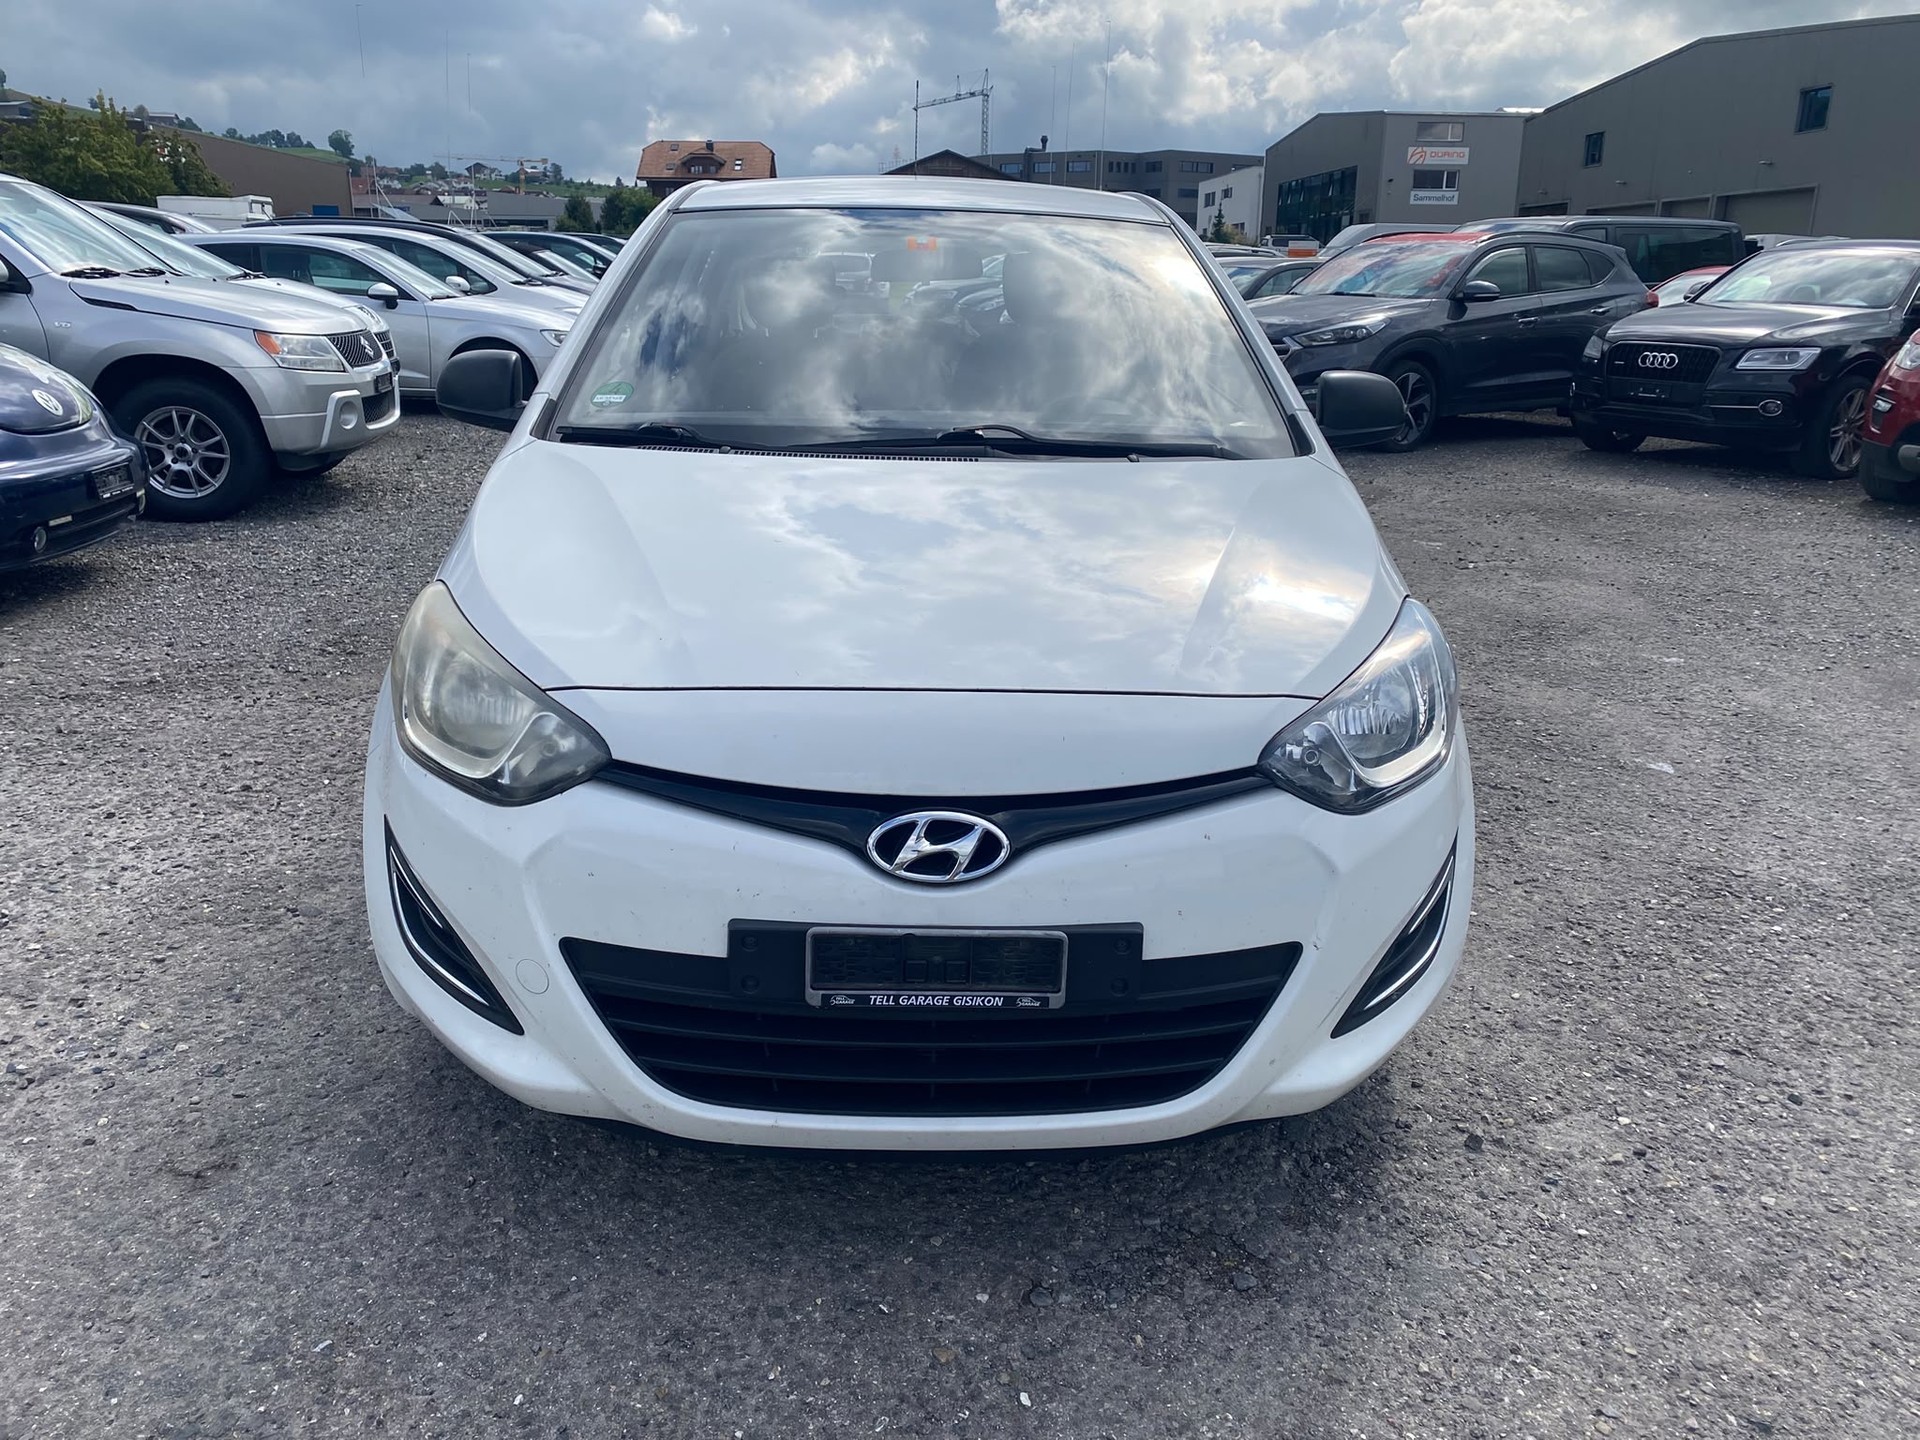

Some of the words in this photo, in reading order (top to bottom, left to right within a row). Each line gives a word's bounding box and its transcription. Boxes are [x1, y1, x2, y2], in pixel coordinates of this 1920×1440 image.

[1413, 194, 1455, 202] Sammelhof
[869, 995, 896, 1006] TELL
[898, 995, 950, 1007] GARAGE
[952, 995, 1004, 1007] GISIKON
